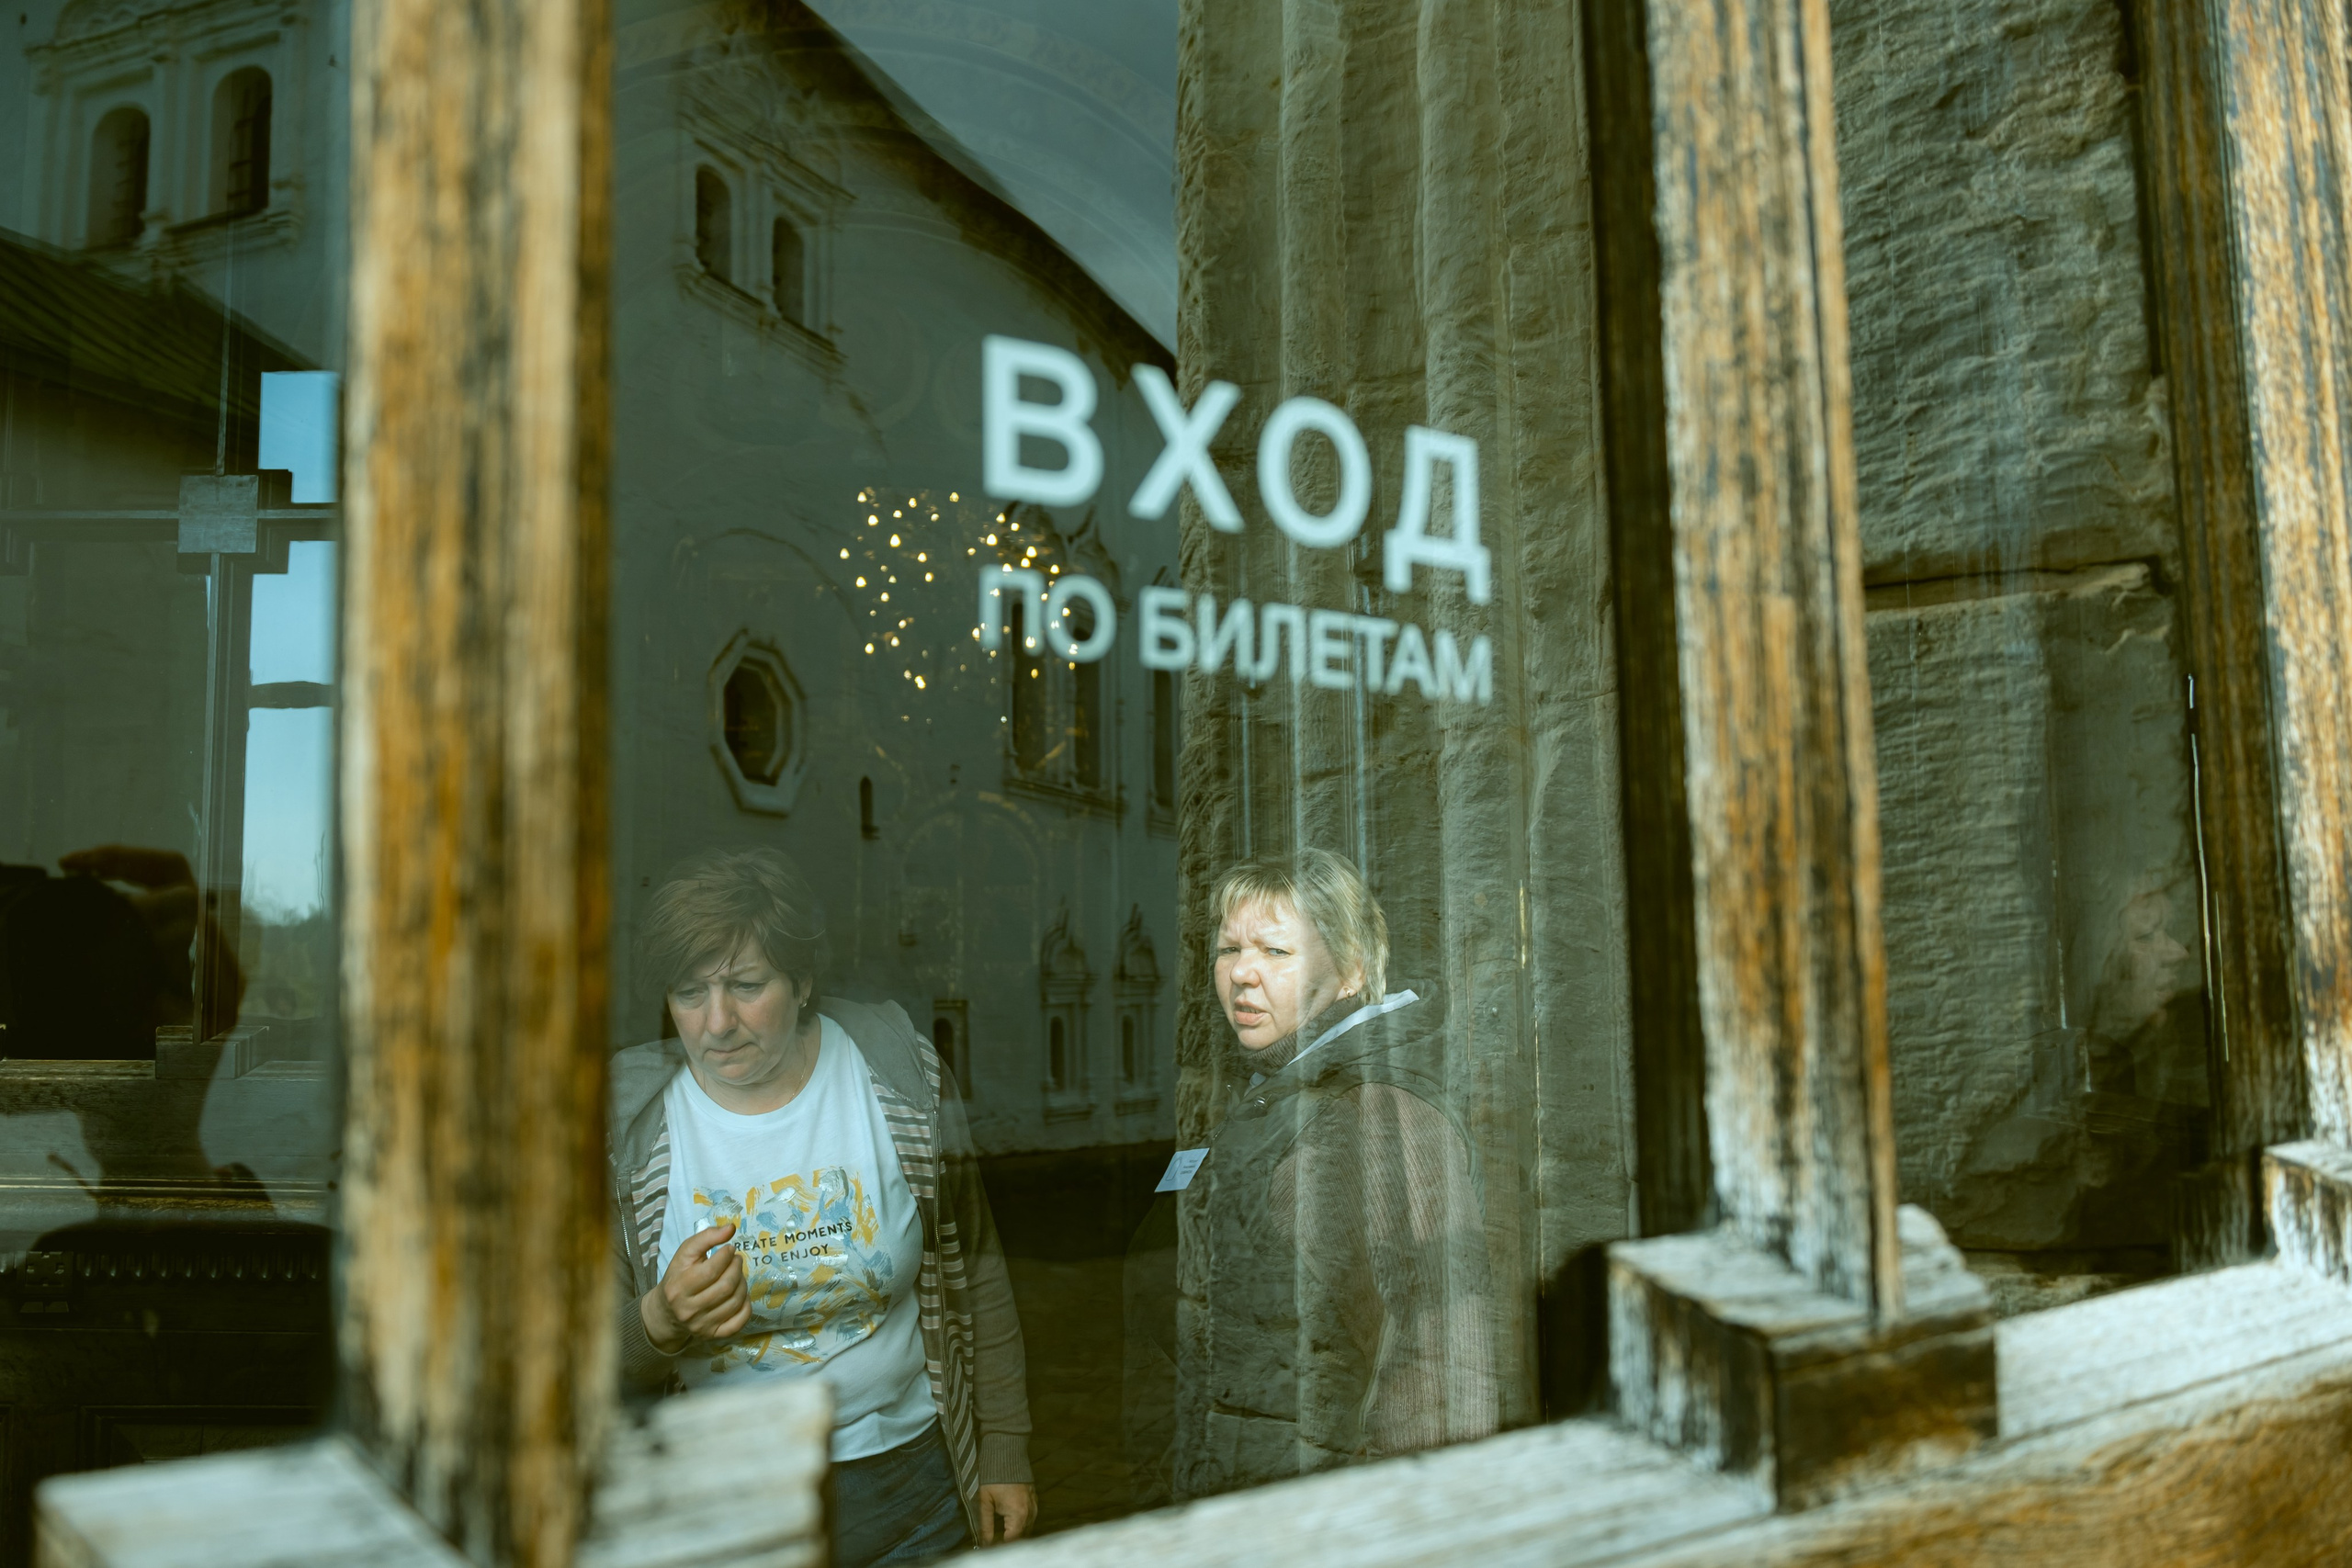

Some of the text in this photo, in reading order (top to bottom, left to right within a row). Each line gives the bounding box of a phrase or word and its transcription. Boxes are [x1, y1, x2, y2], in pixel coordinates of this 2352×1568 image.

[982, 334, 1491, 604] ВХОД
[978, 563, 1493, 704] ПО БИЛЕТАМ
[733, 1221, 853, 1252] REATE MOMENTS
[752, 1243, 829, 1267] TO ENJOY
